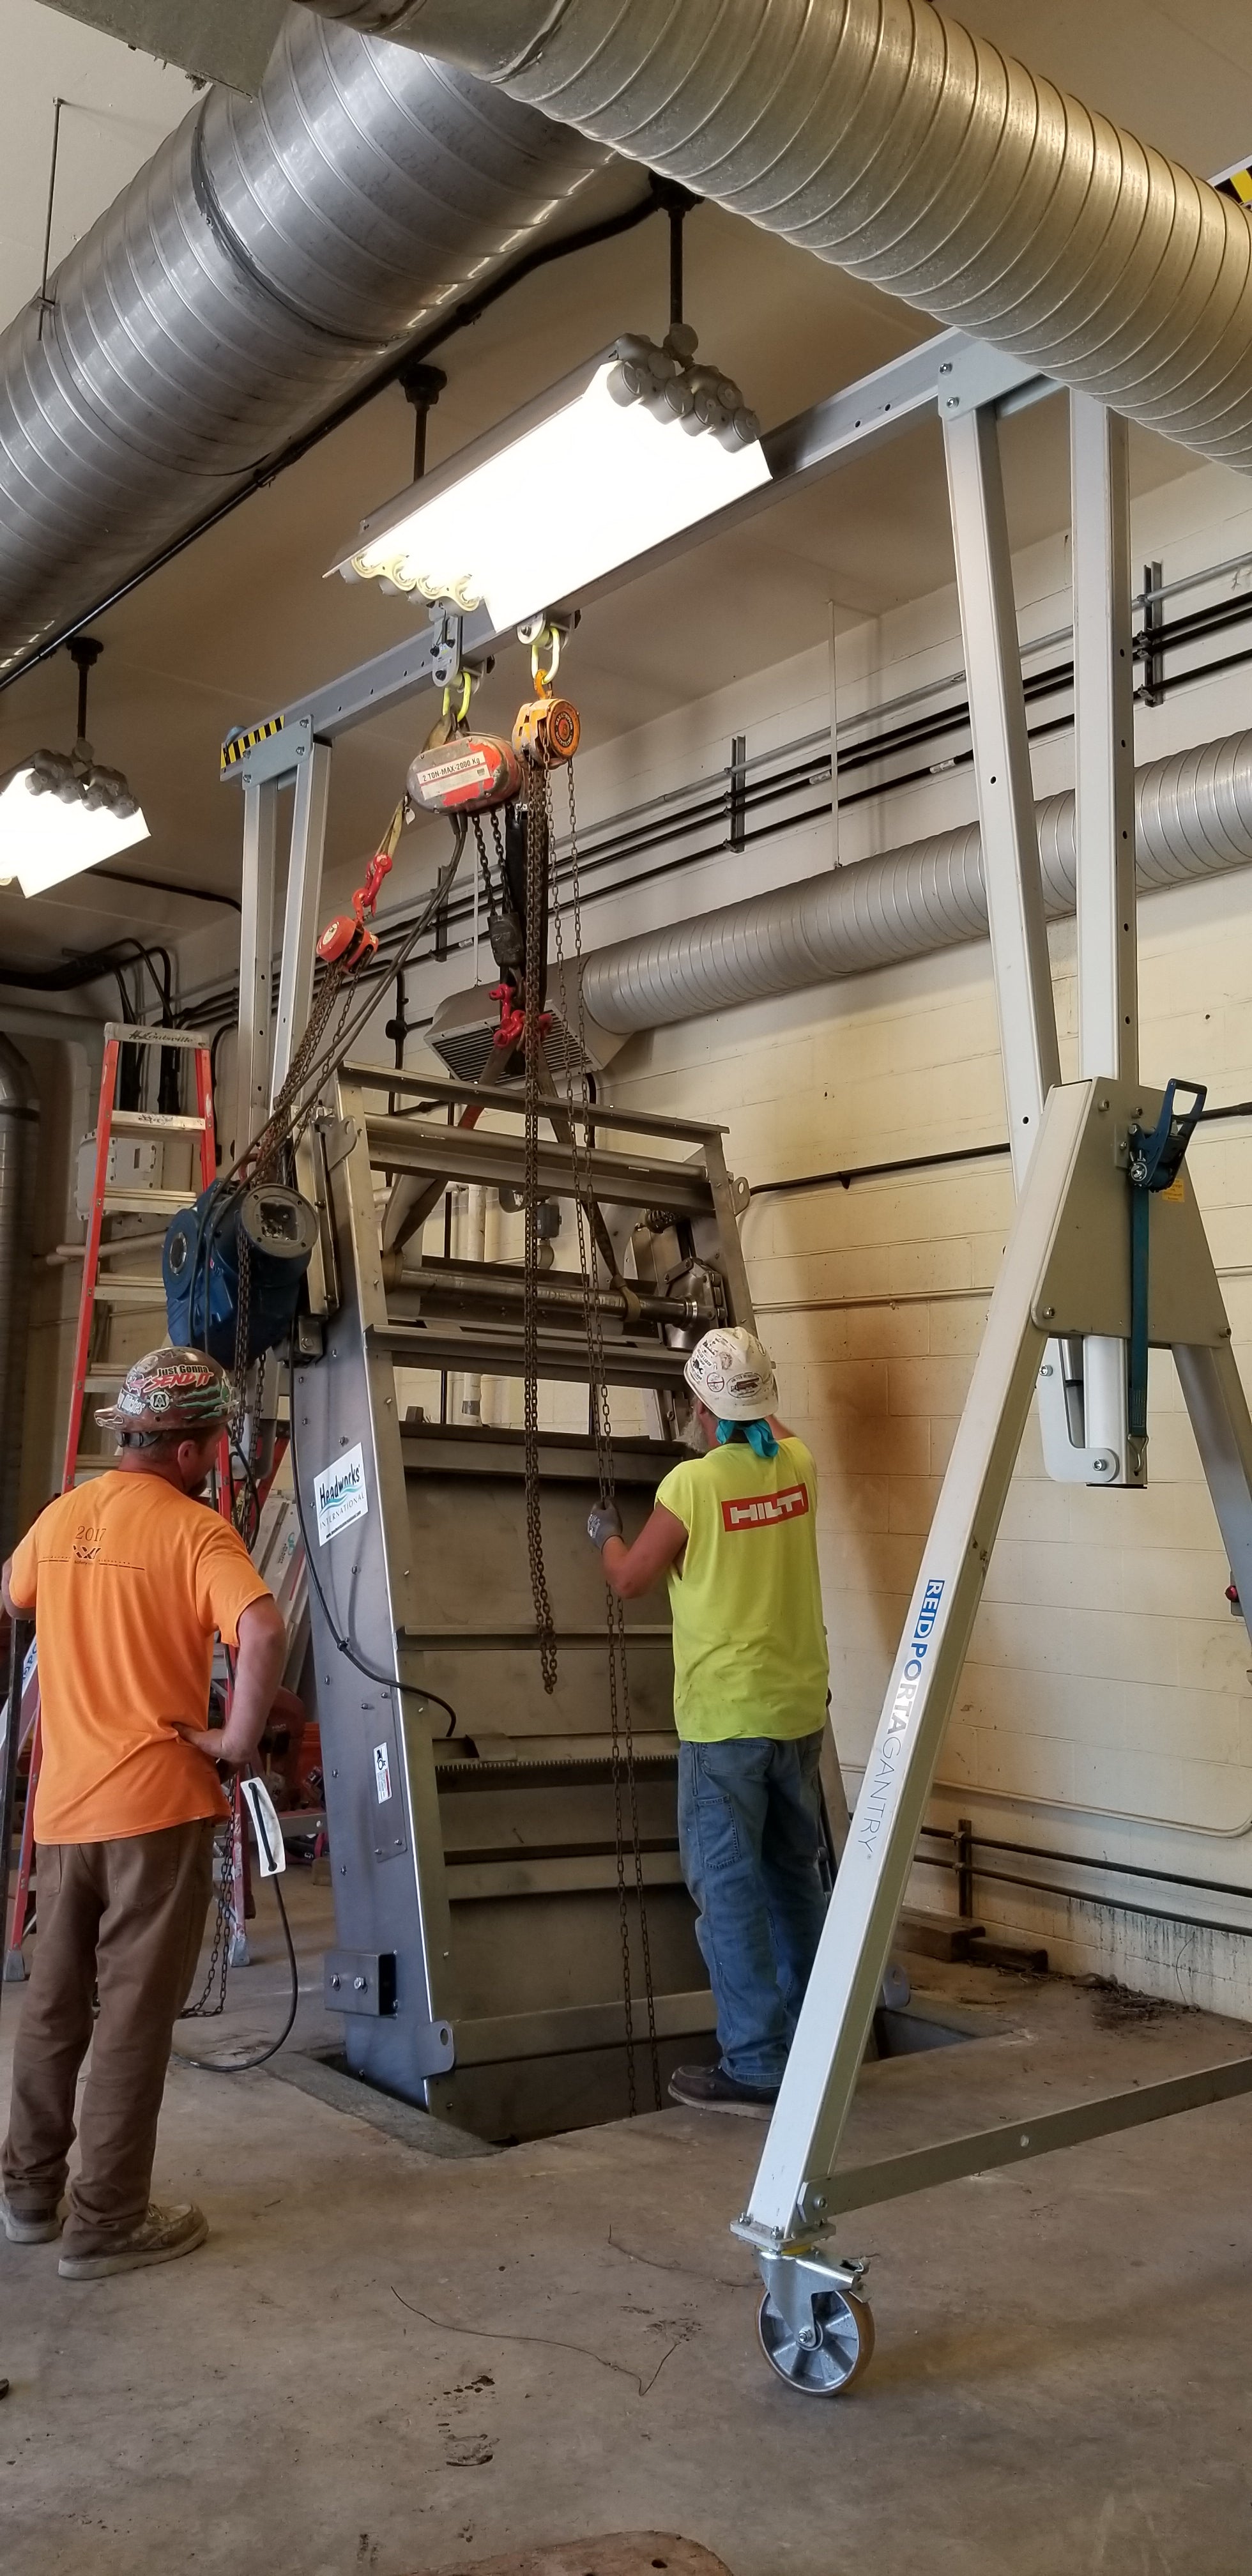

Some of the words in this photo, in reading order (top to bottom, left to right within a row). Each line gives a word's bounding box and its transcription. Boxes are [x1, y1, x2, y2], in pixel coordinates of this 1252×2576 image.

[145, 1031, 193, 1043] Louisville
[144, 1373, 196, 1392] SEND
[195, 1373, 214, 1387] IT
[158, 1366, 178, 1377] Just
[319, 1463, 360, 1509] Headworks
[320, 1492, 365, 1529] INTERNATIONAL
[730, 1491, 805, 1524] HILT
[75, 1526, 106, 1542] 2017
[914, 1579, 945, 1638] REID
